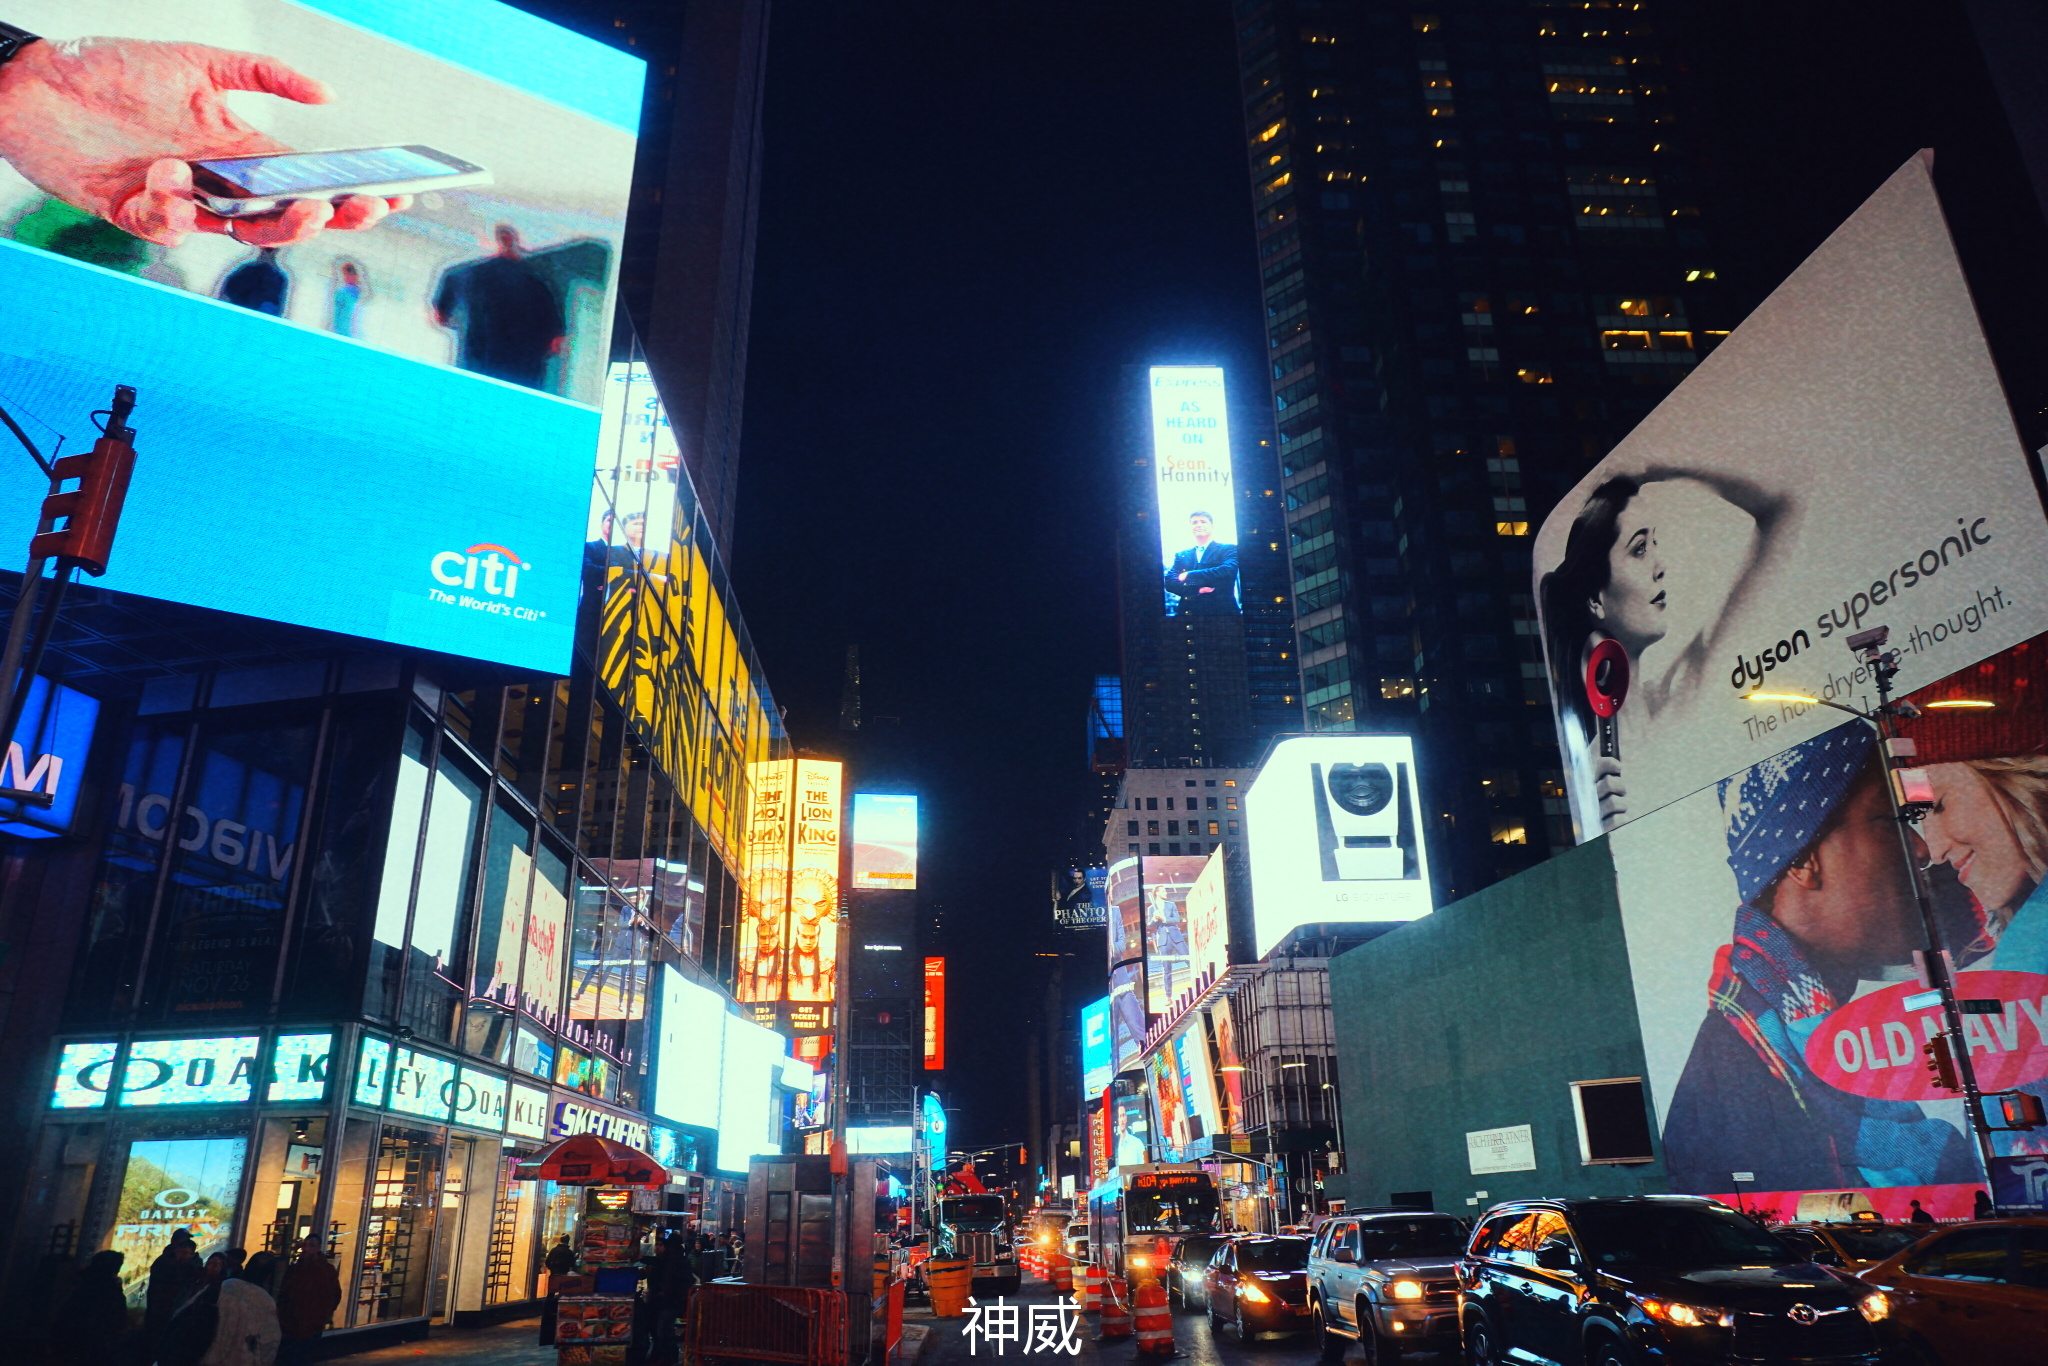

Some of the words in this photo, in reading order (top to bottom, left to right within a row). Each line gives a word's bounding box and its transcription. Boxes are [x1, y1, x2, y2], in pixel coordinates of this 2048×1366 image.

[1180, 401, 1200, 412] AS
[1166, 417, 1217, 428] HEARD
[1182, 433, 1203, 444] ON
[1166, 455, 1206, 470] Sean
[1161, 466, 1230, 487] Hannity
[430, 551, 519, 599] citi
[428, 588, 456, 605] The
[459, 595, 511, 616] World's
[513, 606, 539, 621] Citi
[1731, 629, 1811, 690] dyson
[1817, 517, 1992, 639] supersonic
[1743, 713, 1778, 741] The
[1883, 585, 2012, 668] e-thought.
[805, 791, 829, 801] THE
[801, 803, 832, 821] LION
[797, 823, 837, 844] KING
[1335, 893, 1349, 902] LG
[1054, 906, 1107, 920] PHANTO
[181, 959, 254, 976] SATURDAY
[177, 974, 224, 995] NOV
[227, 973, 251, 992] 26
[791, 1013, 821, 1021] TICKETS
[798, 1006, 814, 1014] GET
[794, 1021, 817, 1029] HERE!
[1834, 1021, 1915, 1073] OLD
[561, 1102, 648, 1151] SKECHERS
[140, 1209, 208, 1220] OAKLEY
